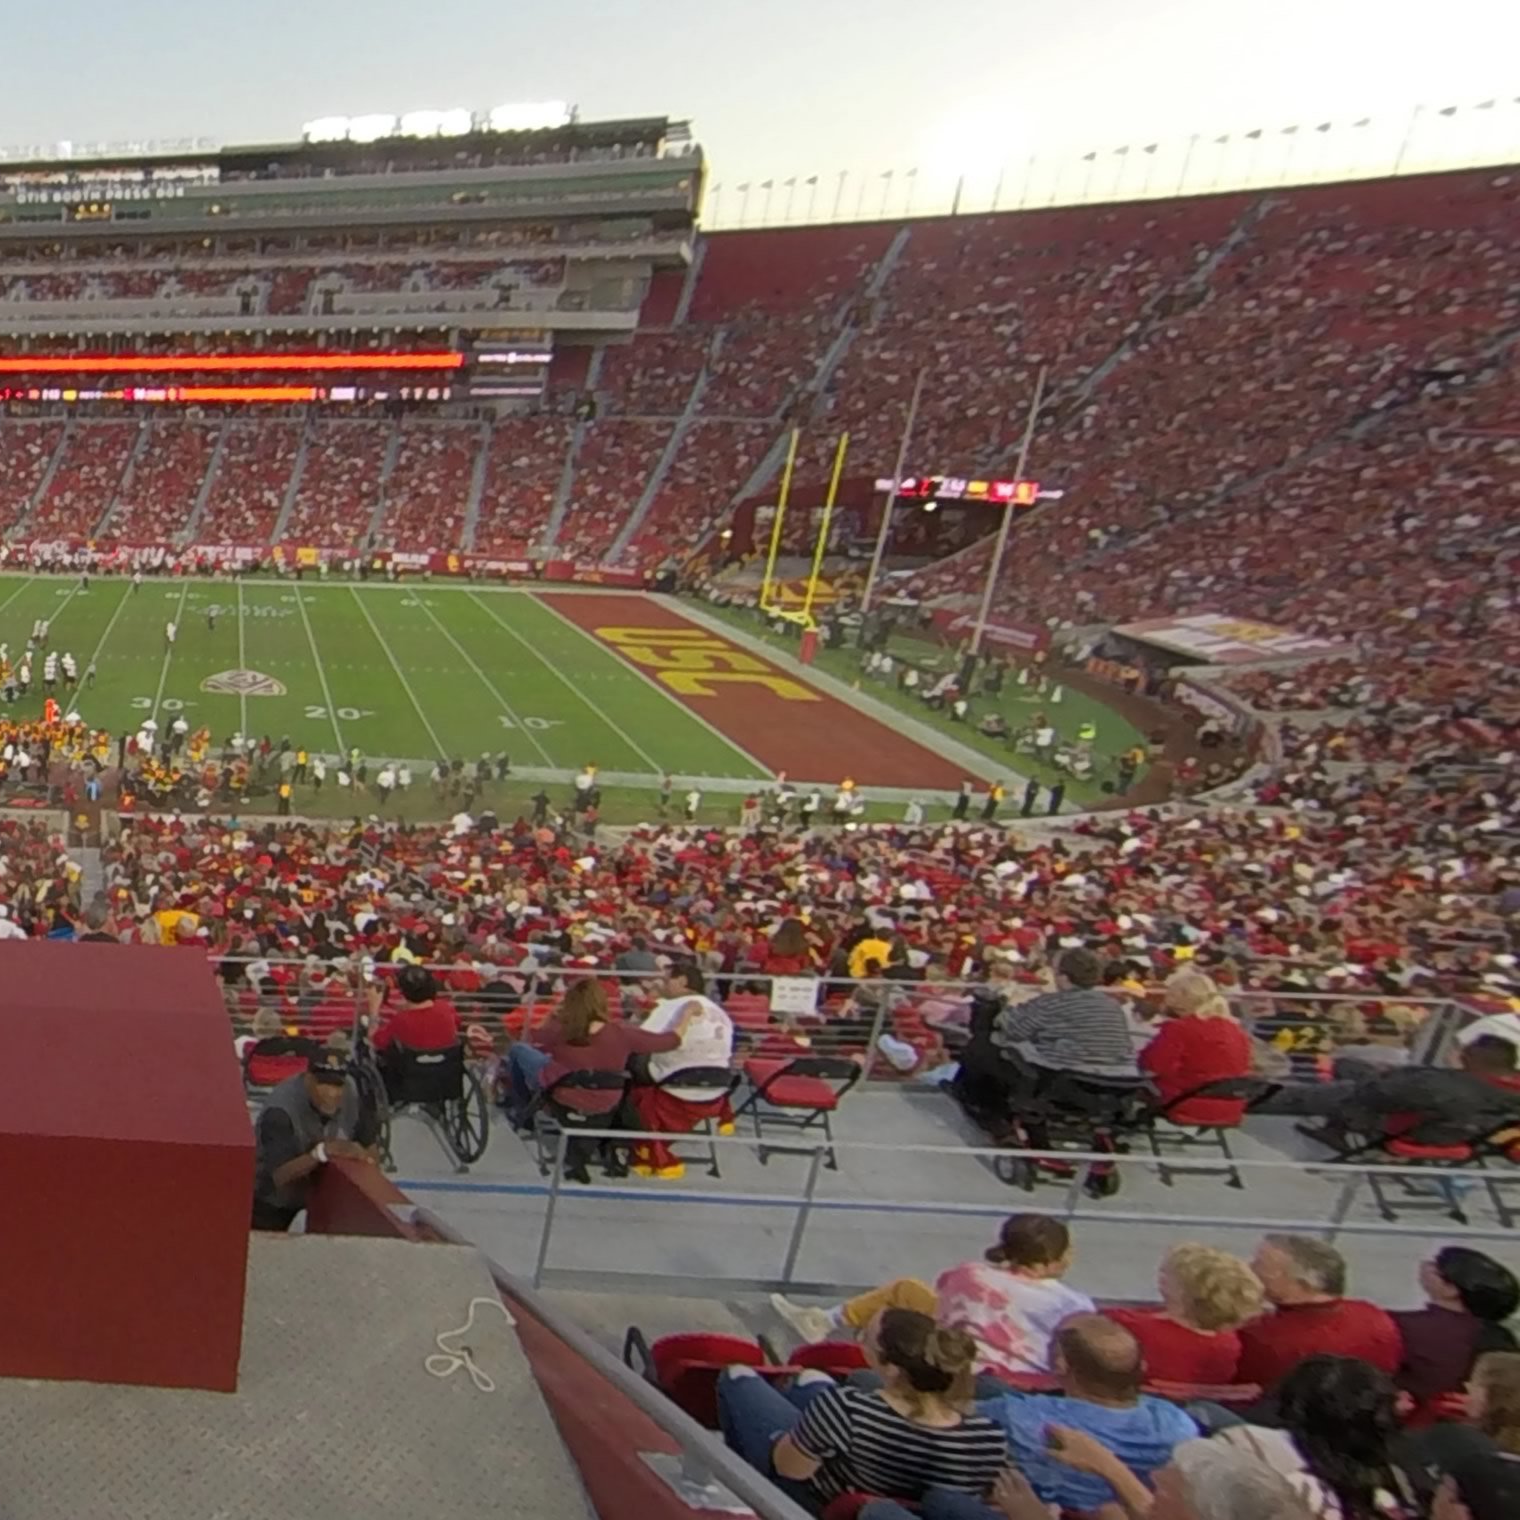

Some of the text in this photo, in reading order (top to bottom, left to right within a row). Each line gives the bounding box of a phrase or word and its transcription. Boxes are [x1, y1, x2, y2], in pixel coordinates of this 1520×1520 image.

[593, 626, 822, 702] USC
[130, 696, 184, 711] 30
[304, 705, 362, 720] 20
[497, 714, 551, 730] 10
